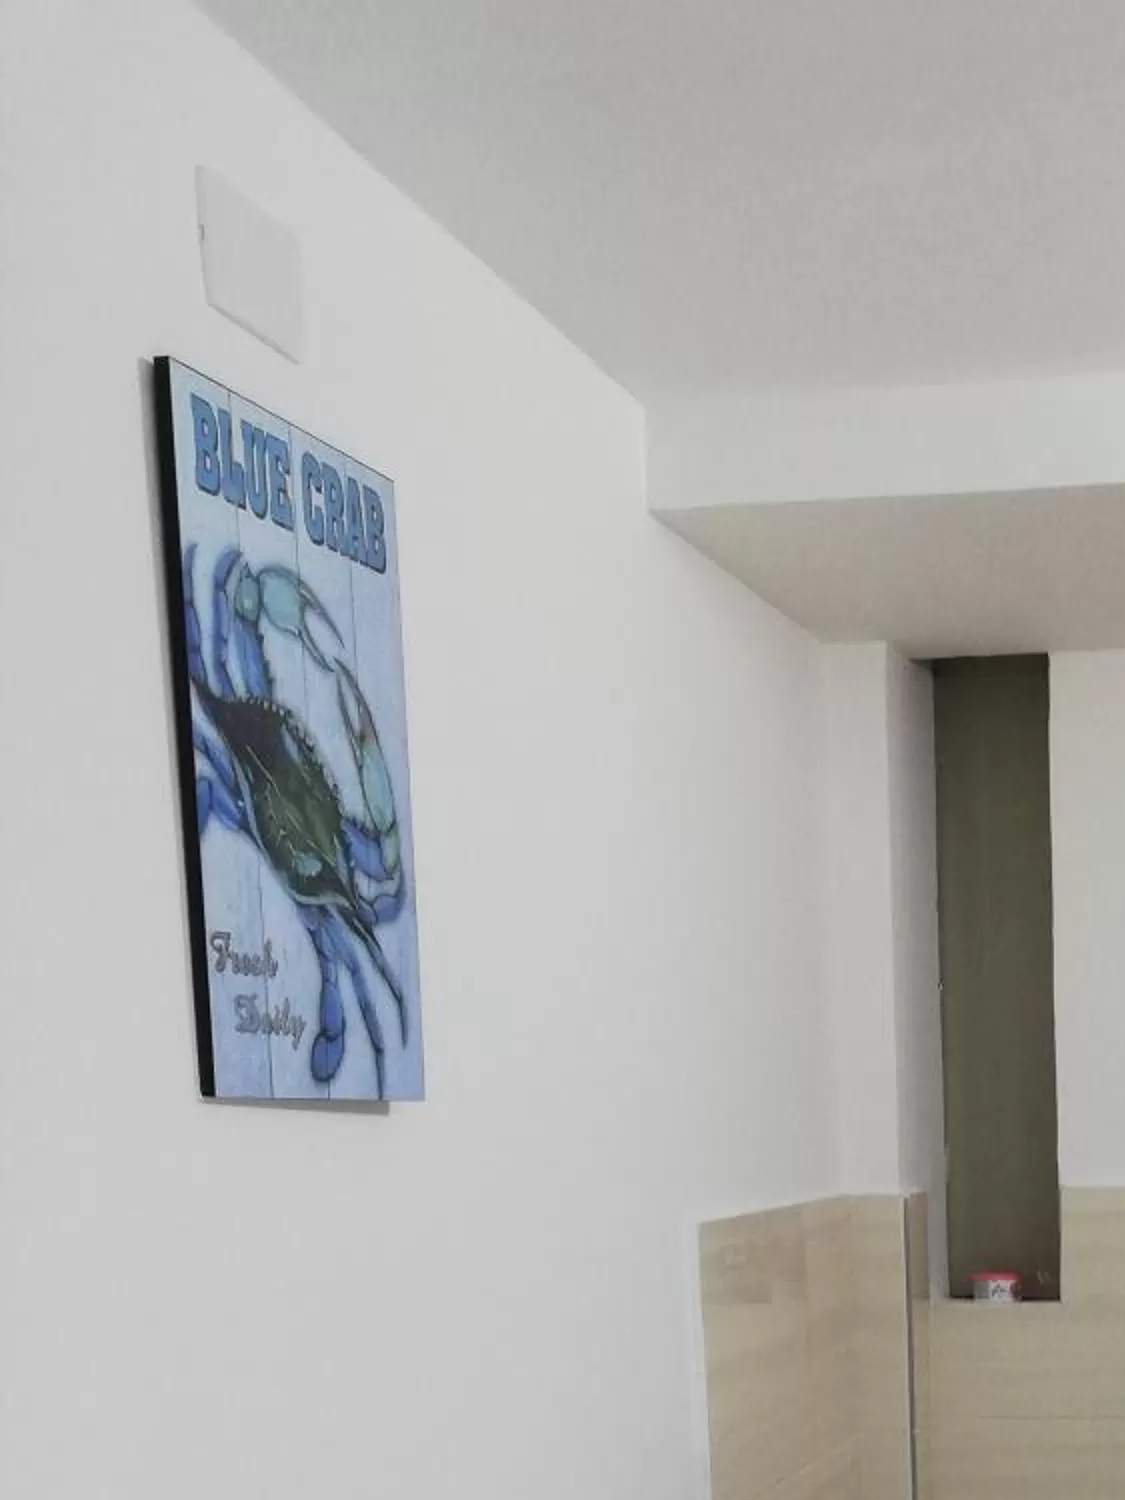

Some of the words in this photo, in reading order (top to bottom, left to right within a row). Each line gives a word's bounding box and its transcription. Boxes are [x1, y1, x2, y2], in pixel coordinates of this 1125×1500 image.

[190, 393, 296, 532] BLUE
[301, 451, 387, 575] CRAB
[210, 931, 278, 978] Fresh
[233, 992, 307, 1051] Daily
